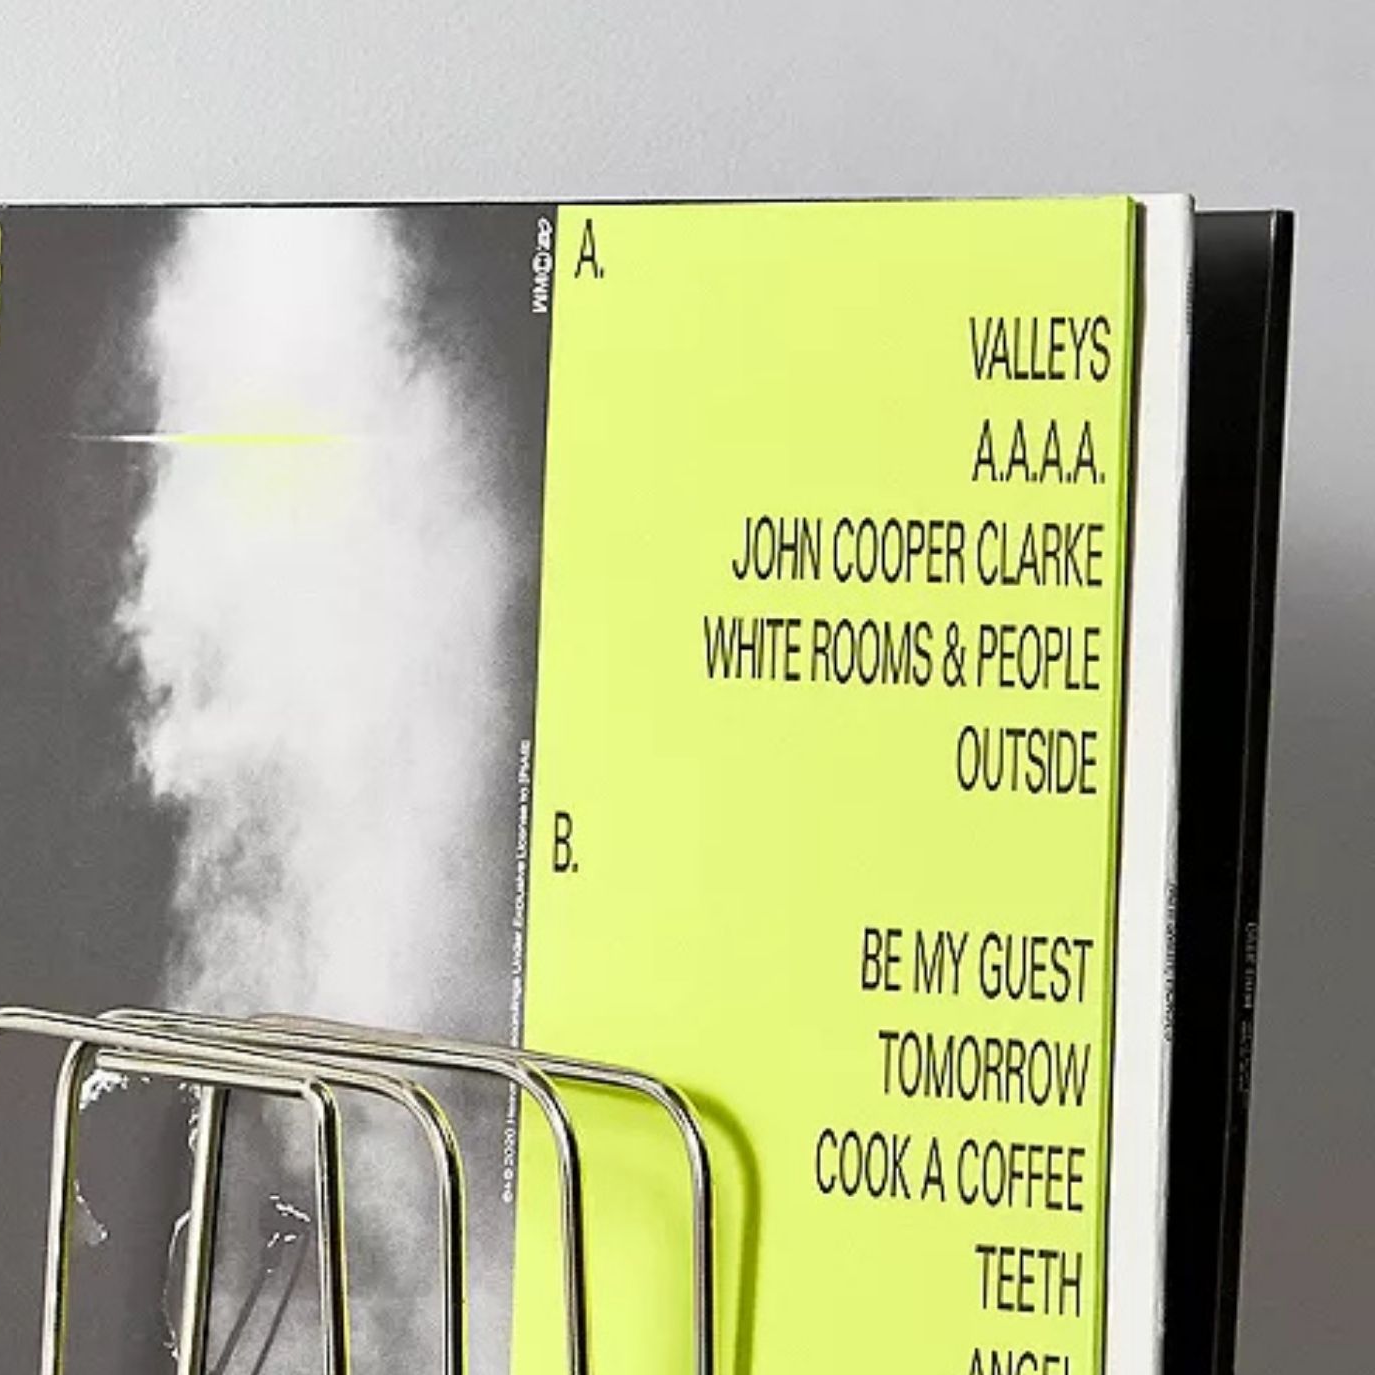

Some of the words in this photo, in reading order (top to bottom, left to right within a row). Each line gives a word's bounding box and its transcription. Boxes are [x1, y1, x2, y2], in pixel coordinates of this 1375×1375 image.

[575, 218, 605, 279] A.
[970, 316, 1112, 381] VALLEYS
[972, 419, 1106, 484] A.A.A.A.
[732, 516, 821, 581] JOHN
[833, 517, 964, 585] COOPER
[976, 521, 1104, 588] CLARKE
[704, 615, 801, 682] WHITE
[811, 618, 932, 688] ROOMS
[943, 621, 966, 688] &
[977, 625, 1101, 690] PEOPLE
[957, 726, 1098, 795] OUTSIDE
[552, 811, 578, 874] B.
[861, 928, 902, 993] BE
[913, 931, 968, 996] MY
[978, 934, 1095, 1004] GUEST
[878, 1031, 1092, 1107] TOMORROW
[815, 1128, 911, 1200] COOK
[920, 1136, 945, 1203] A
[957, 1140, 1085, 1213] COFFEE
[975, 1245, 1083, 1318] TEETH
